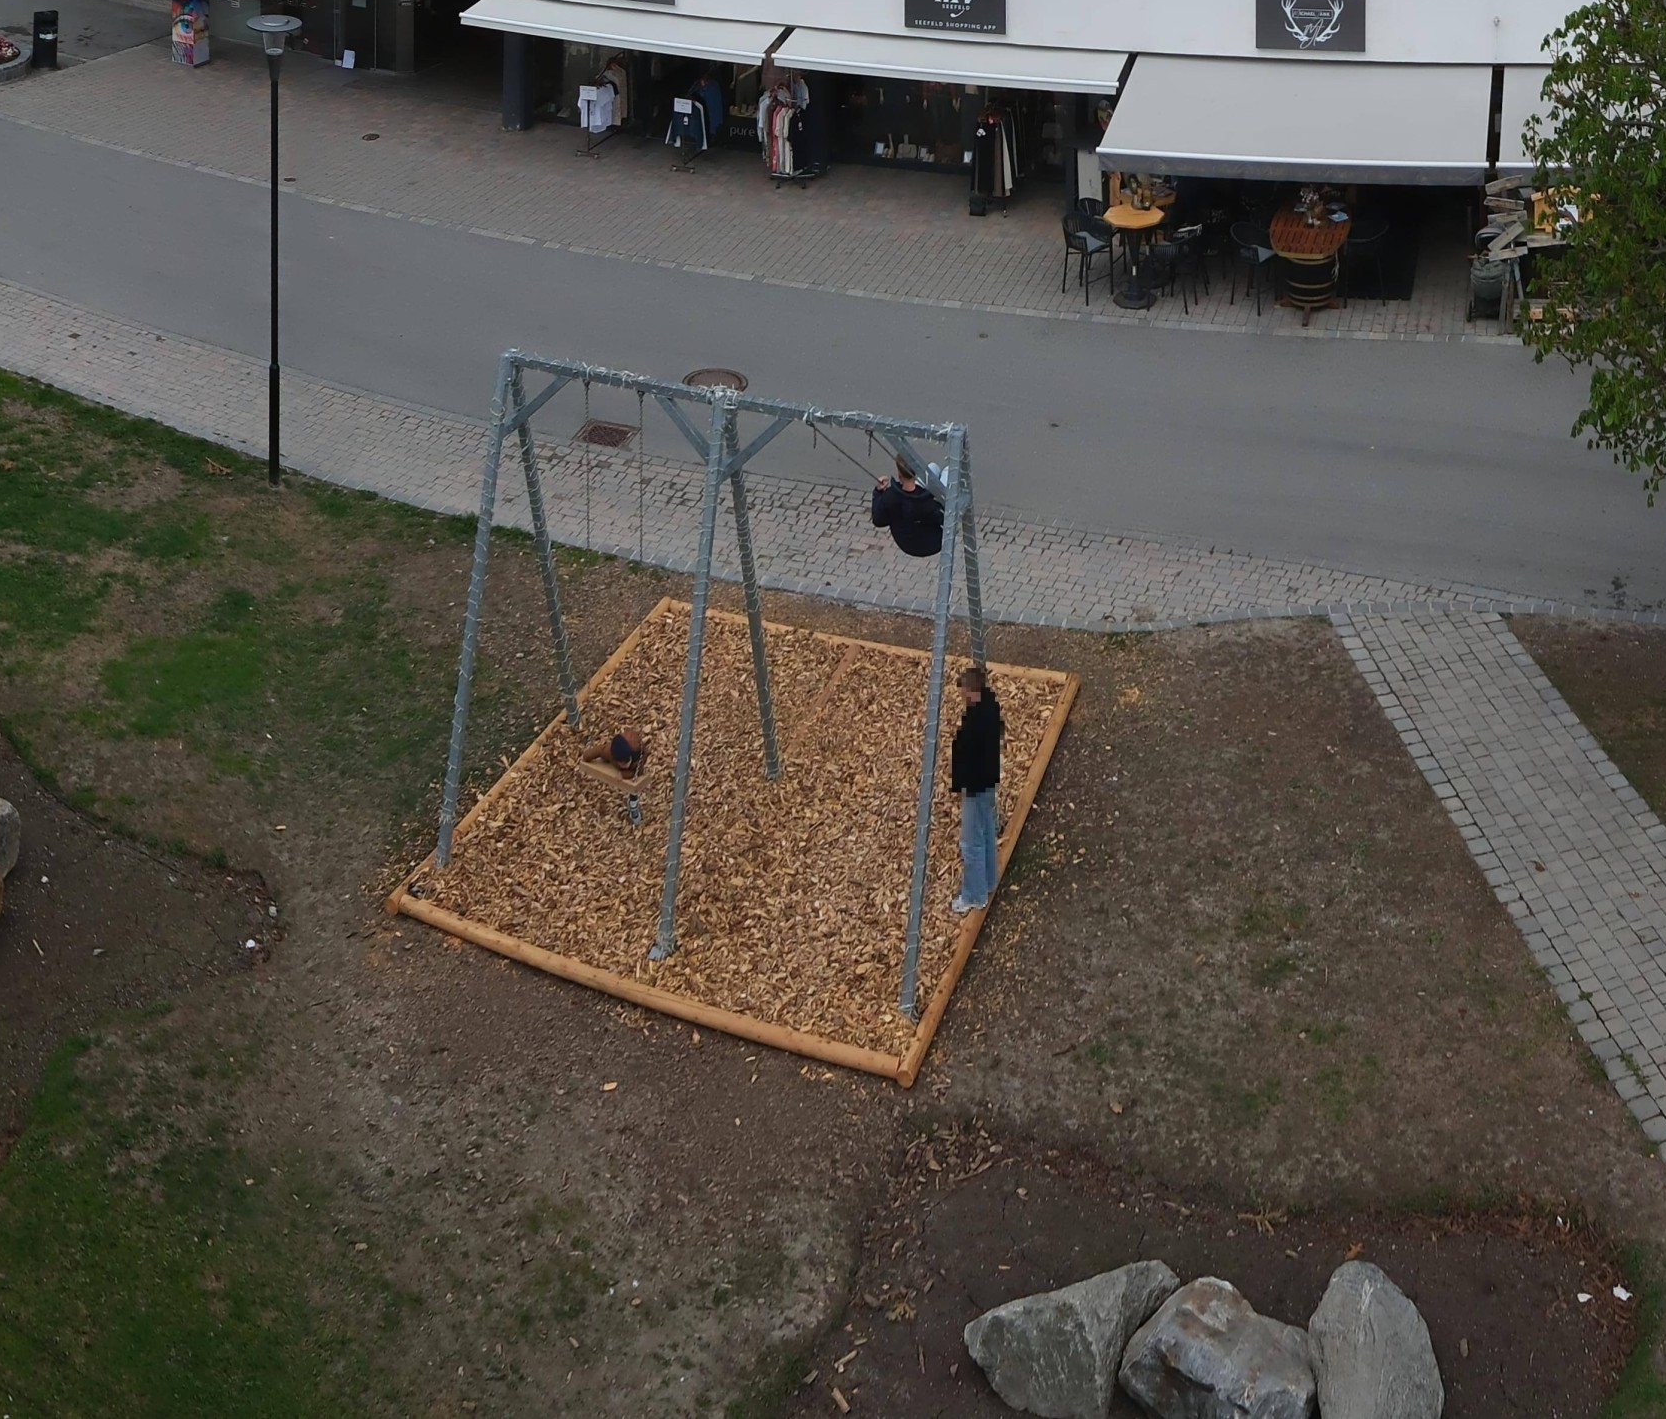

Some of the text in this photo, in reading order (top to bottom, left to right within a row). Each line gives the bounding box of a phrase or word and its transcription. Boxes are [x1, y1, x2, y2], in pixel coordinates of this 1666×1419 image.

[942, 3, 971, 11] SEEFELD
[915, 19, 944, 27] SEEFELD
[946, 22, 981, 30] SHOPPING
